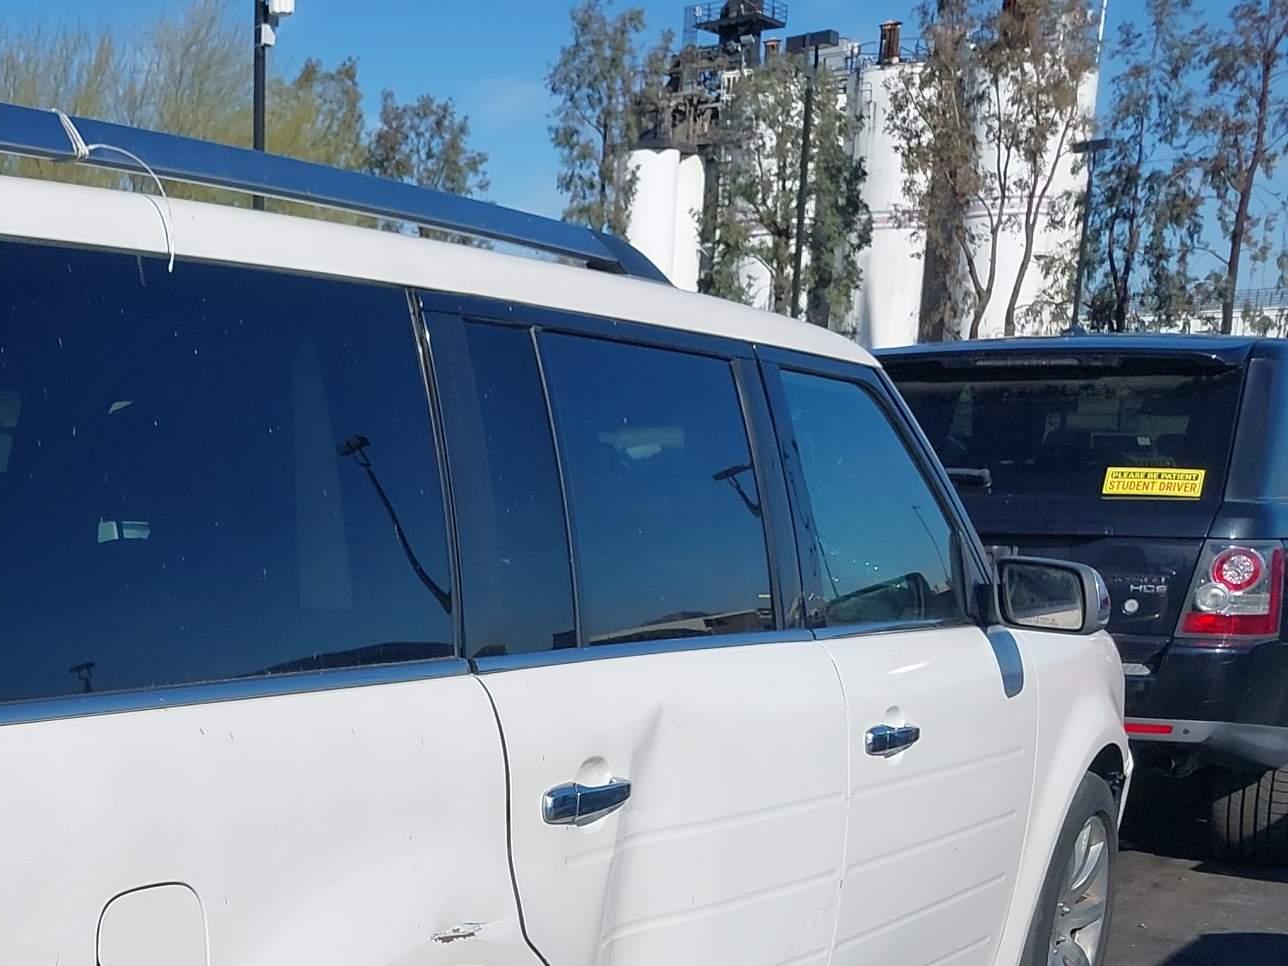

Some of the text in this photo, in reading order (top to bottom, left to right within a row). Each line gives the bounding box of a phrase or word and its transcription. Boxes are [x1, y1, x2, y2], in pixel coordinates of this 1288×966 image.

[1112, 471, 1198, 481] PLEASE BE PATIENT
[1108, 480, 1198, 493] STUDENT DRIVER
